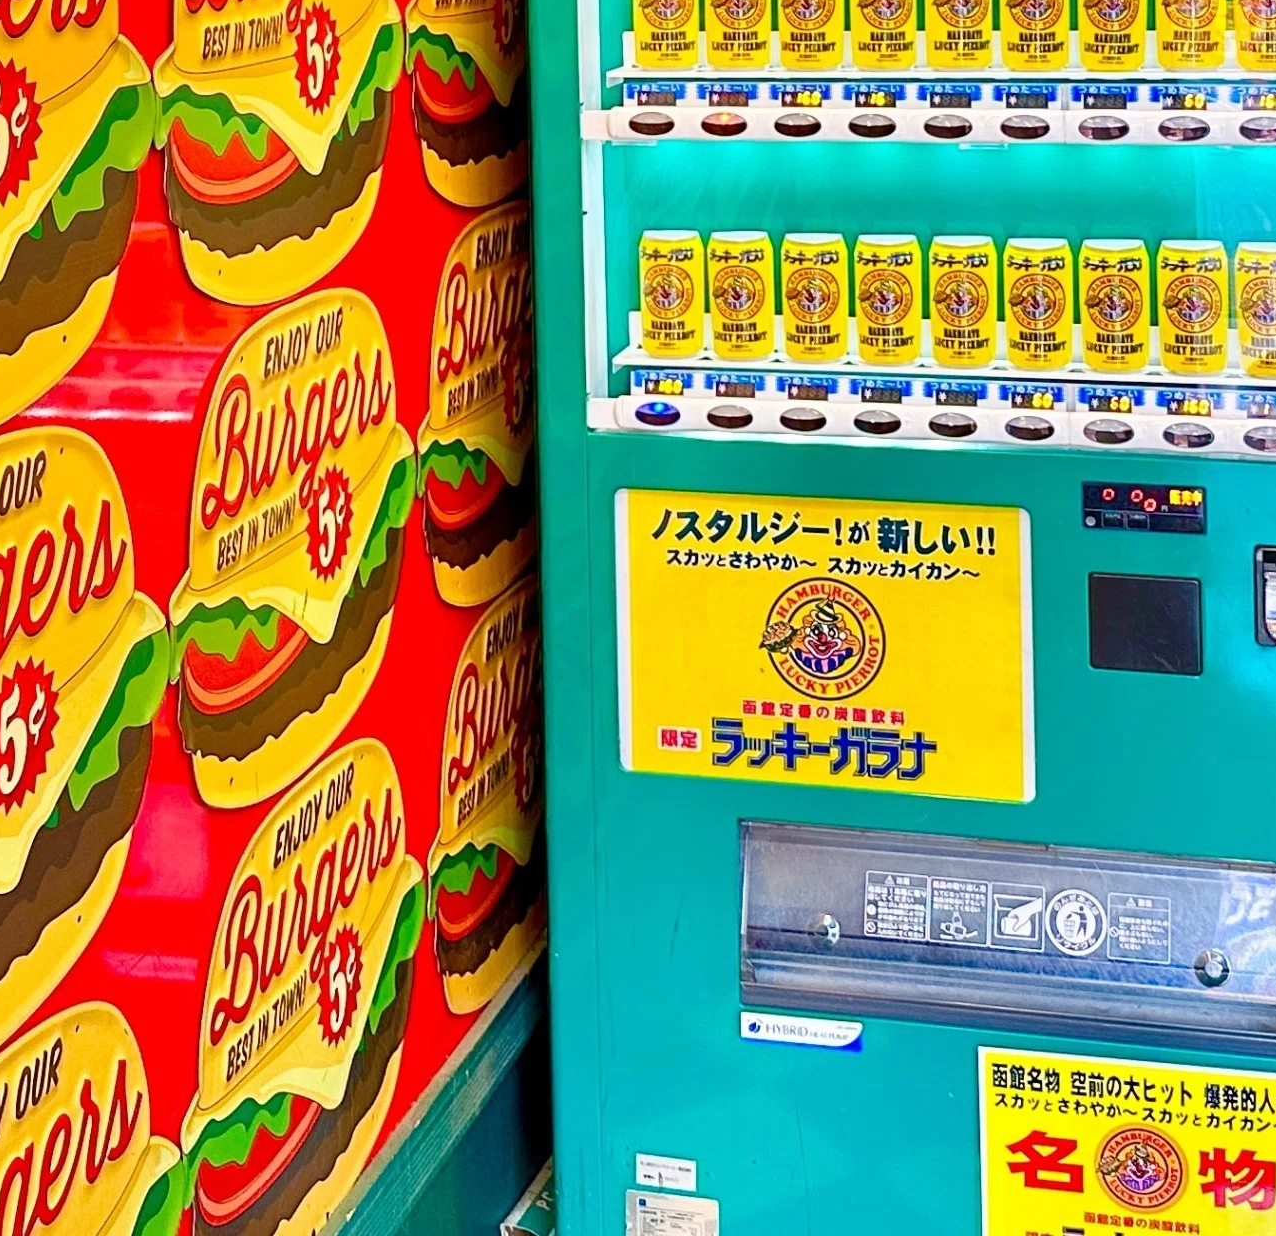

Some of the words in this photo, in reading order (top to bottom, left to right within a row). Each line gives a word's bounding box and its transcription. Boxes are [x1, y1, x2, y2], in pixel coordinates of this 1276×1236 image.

[202, 24, 230, 60] BEST
[233, 20, 245, 51] IN
[249, 13, 283, 49] TOWN!
[307, 18, 334, 99] 5¢
[777, 584, 871, 621] HAMBURGER
[779, 657, 830, 694] LUCKY
[835, 635, 880, 693] PIERROT
[661, 729, 698, 749] 限定
[712, 717, 937, 780] ラッキーガラナ
[272, 794, 323, 869] ENJOY
[325, 762, 355, 818] OUR
[210, 786, 401, 1046] Burgers
[328, 948, 356, 1033] 5¢
[225, 1033, 253, 1083] BEST
[255, 1014, 270, 1055] IN
[272, 970, 307, 1035] TOWN!
[992, 1063, 1060, 1093] 函館名物
[1071, 1070, 1192, 1107] 空前の大ヒット
[1006, 1130, 1084, 1193] 名
[1198, 1147, 1276, 1210] 物
[1107, 1132, 1174, 1158] HAMBURGER
[1111, 1177, 1145, 1204] LUCKY
[1148, 1167, 1179, 1204] PIERROT
